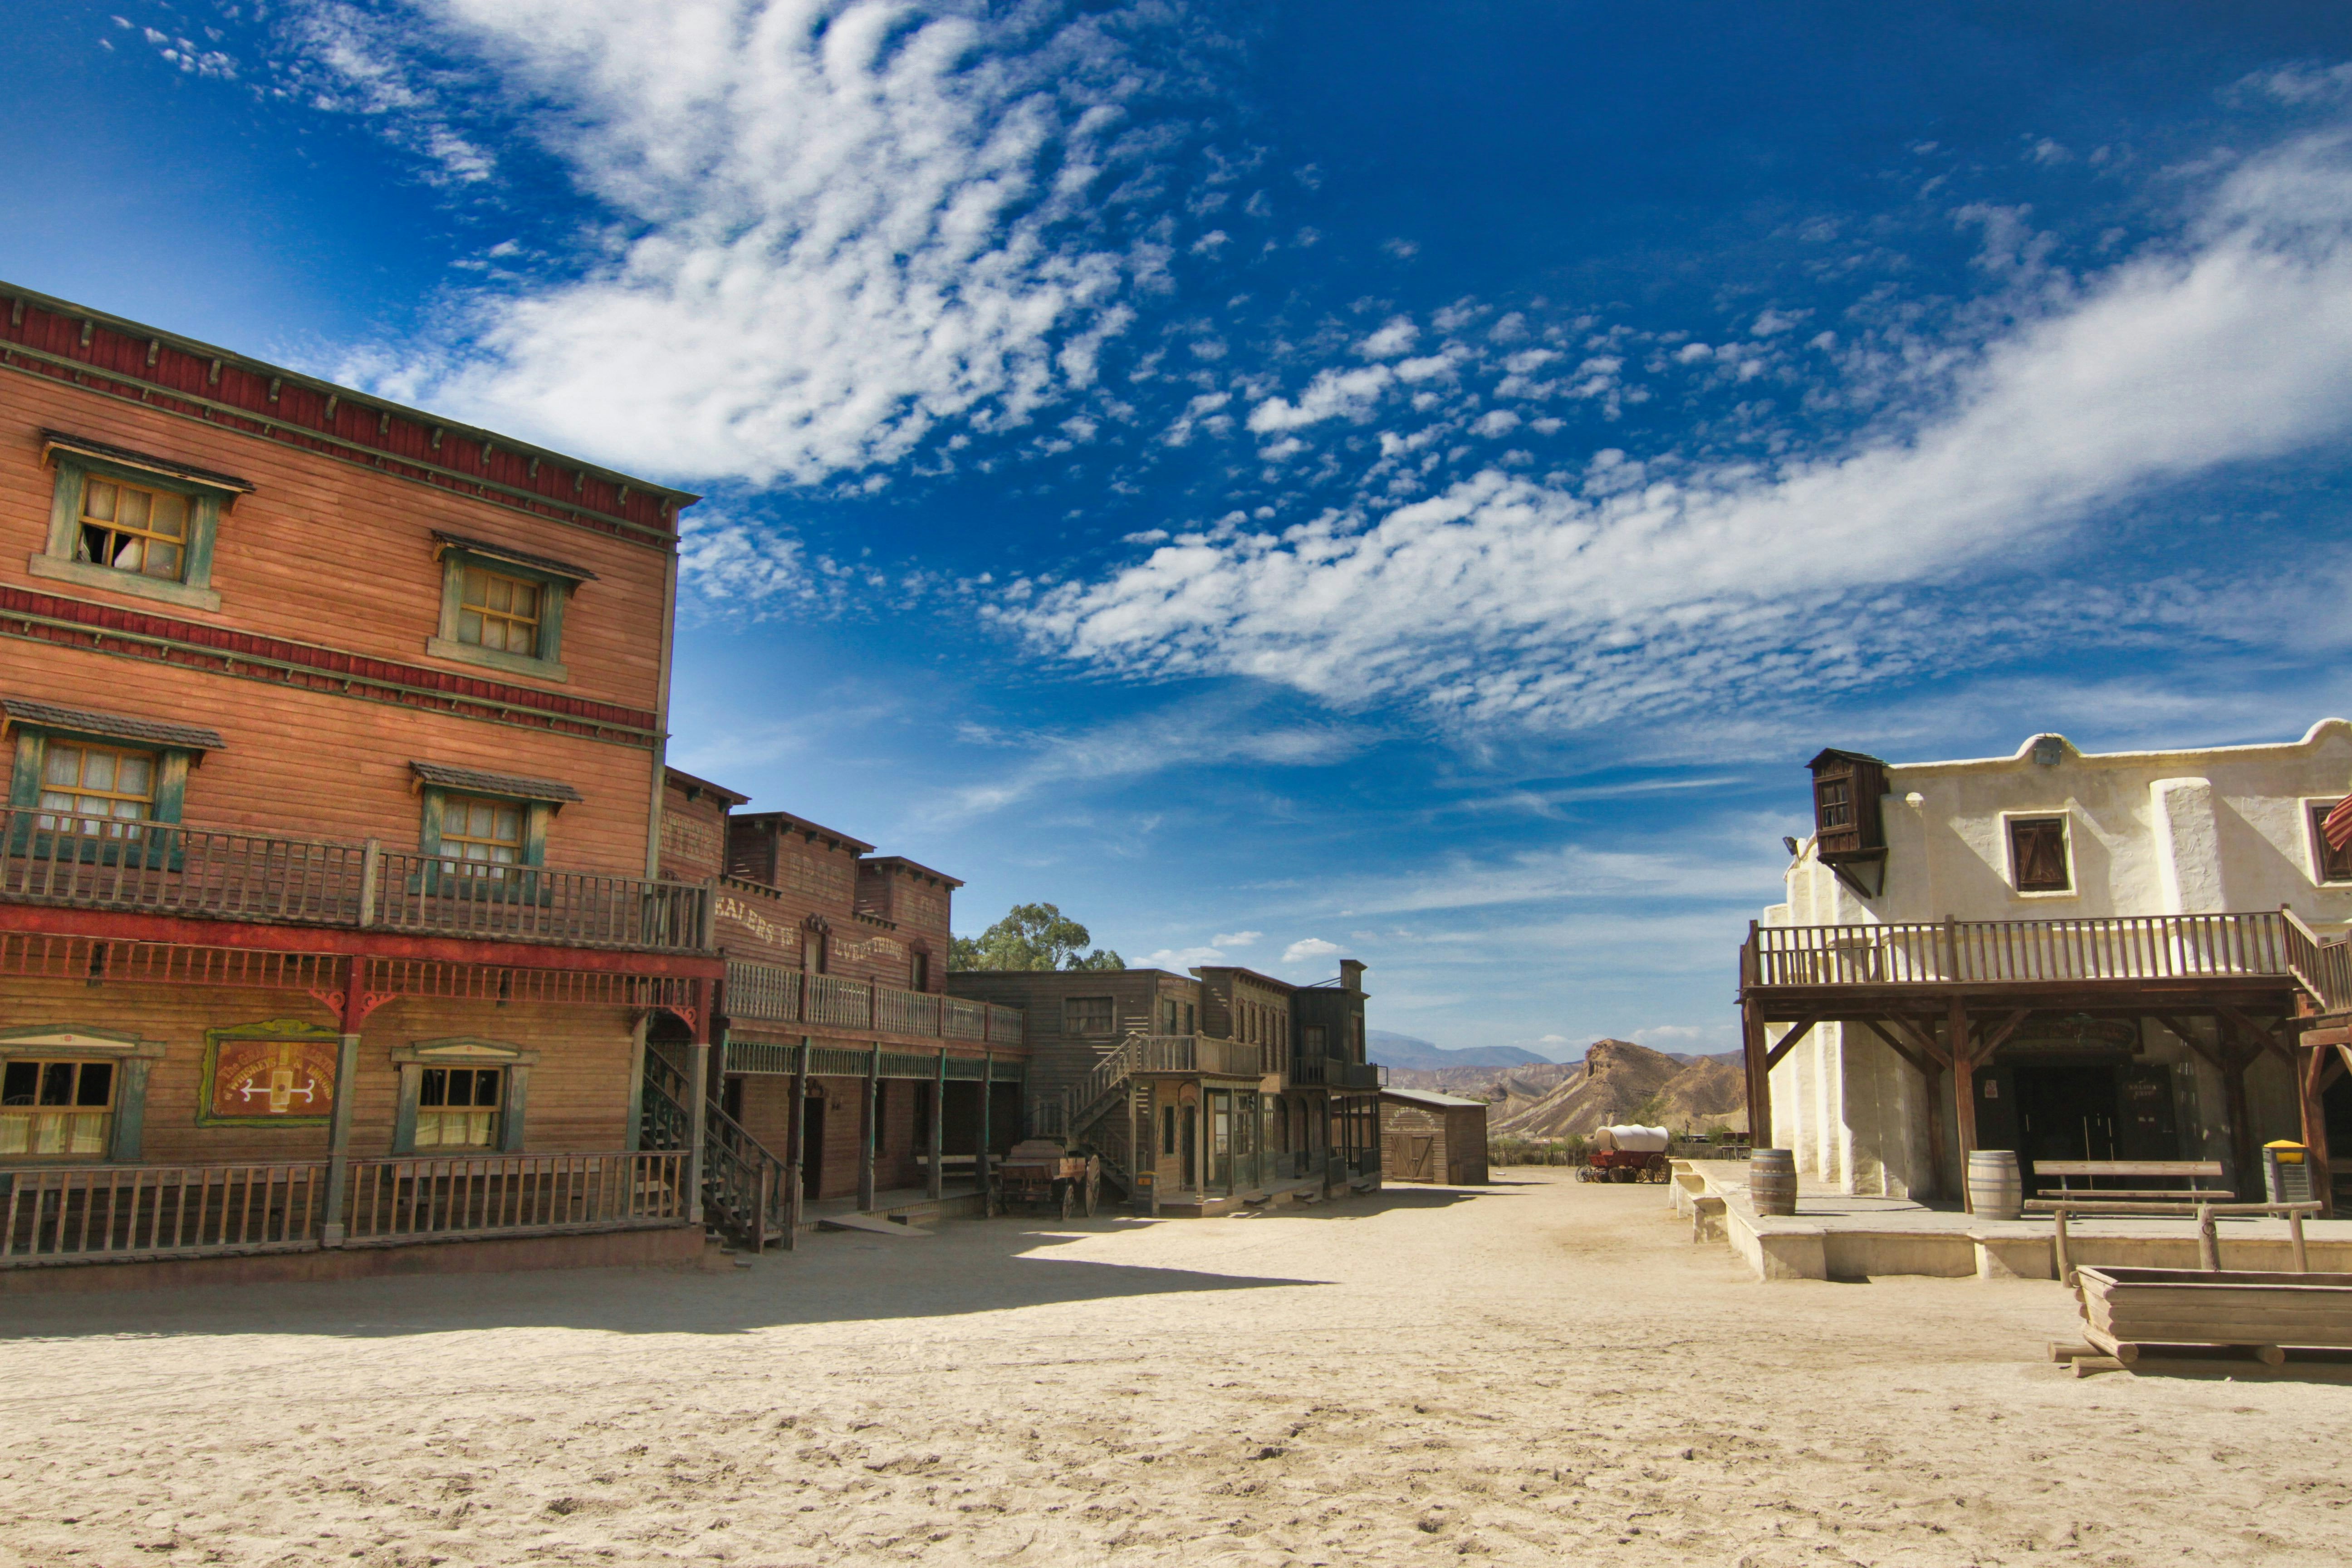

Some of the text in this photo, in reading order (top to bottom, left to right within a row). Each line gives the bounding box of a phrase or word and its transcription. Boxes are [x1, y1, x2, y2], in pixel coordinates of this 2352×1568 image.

[714, 897, 774, 943] EALERS
[780, 927, 794, 946] IN
[219, 1063, 240, 1079] The
[226, 1057, 276, 1090] WHISKEYS
